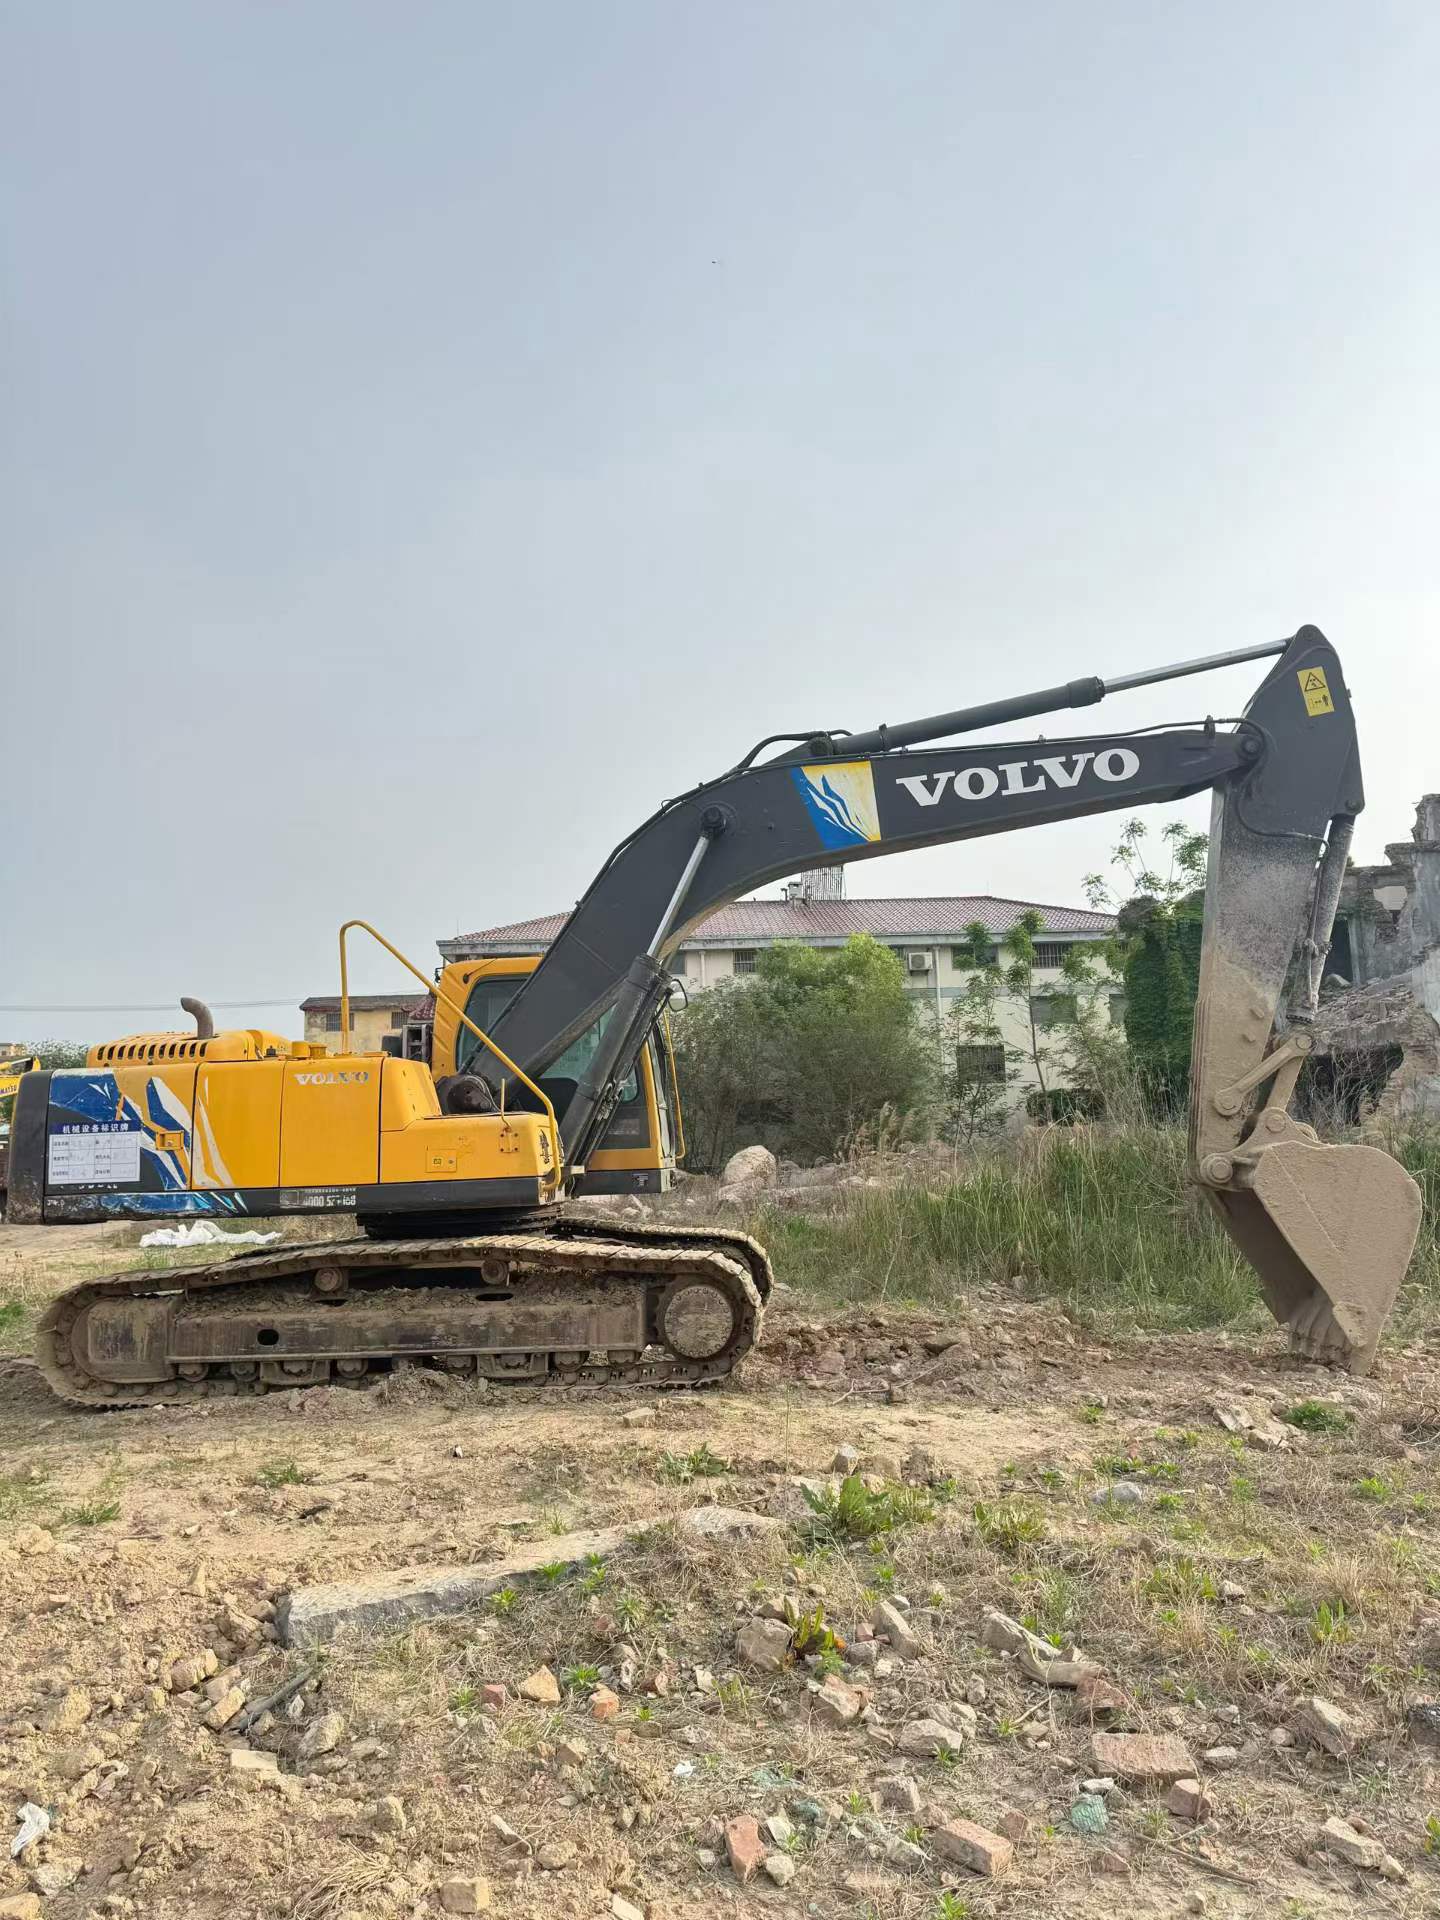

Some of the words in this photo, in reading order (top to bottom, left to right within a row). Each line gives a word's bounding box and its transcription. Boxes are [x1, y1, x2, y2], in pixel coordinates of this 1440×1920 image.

[896, 748, 1140, 807] VOLVO
[293, 1071, 369, 1086] VOLVO
[62, 1123, 129, 1134] 机械设备标识牌
